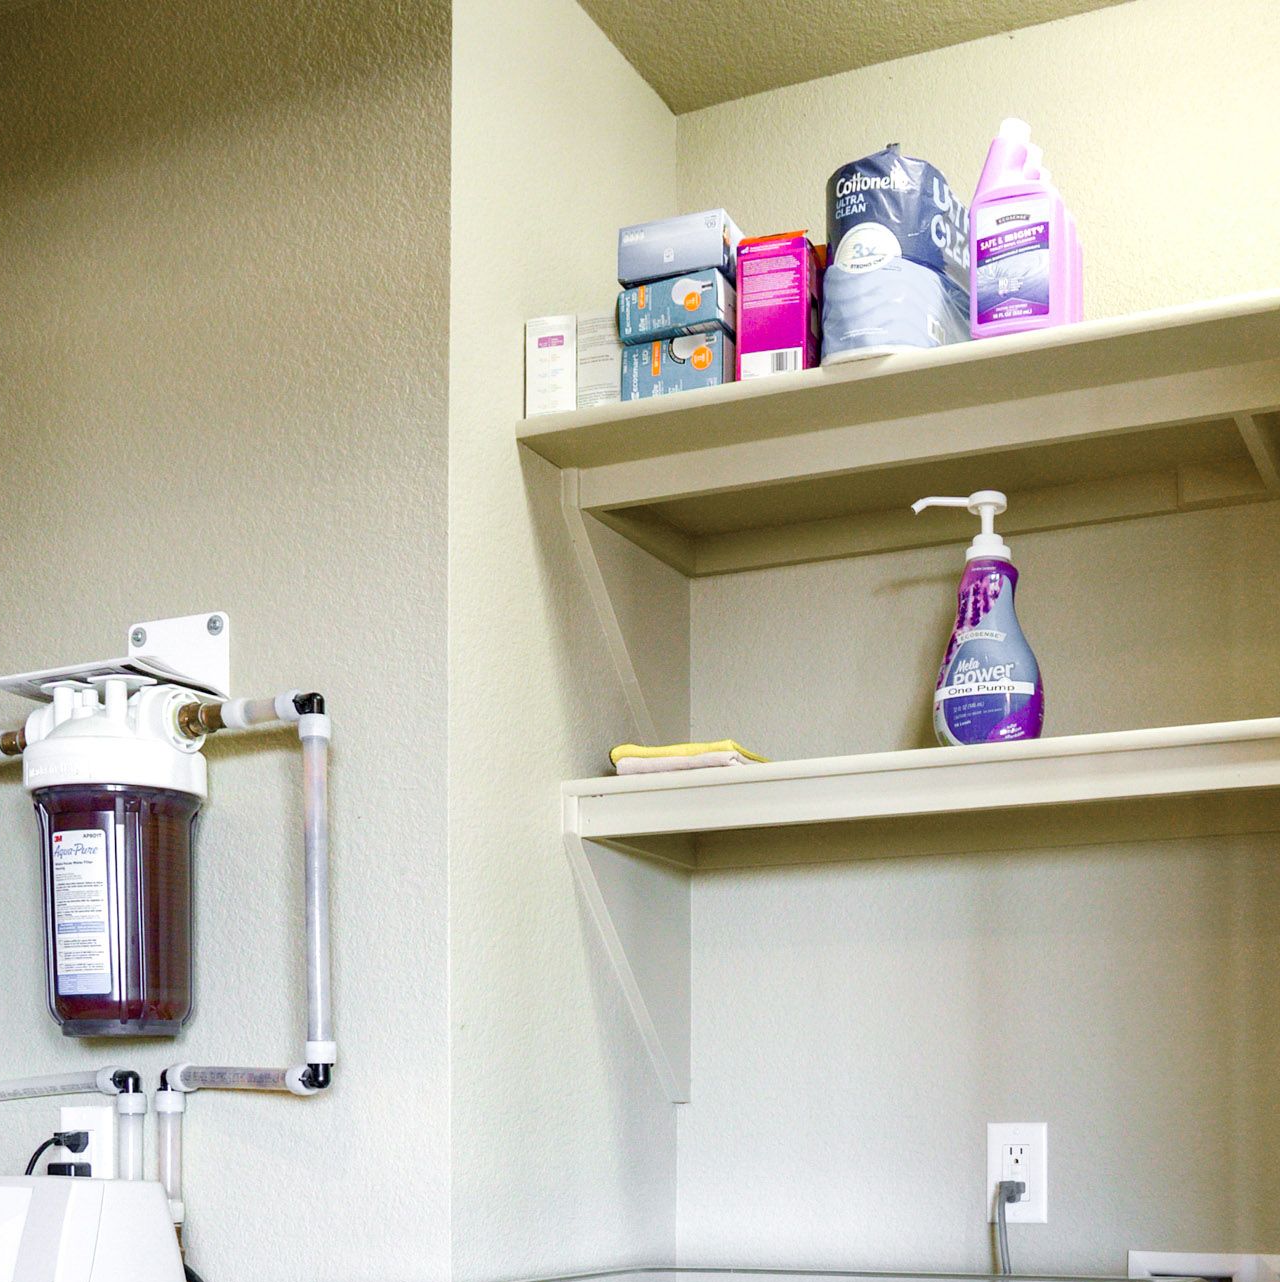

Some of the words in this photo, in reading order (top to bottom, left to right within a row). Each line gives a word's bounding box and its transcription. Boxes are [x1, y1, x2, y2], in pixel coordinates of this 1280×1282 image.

[836, 169, 908, 198] Cottonel
[836, 193, 865, 210] ULTRA
[835, 202, 867, 219] CLEAN
[948, 687, 972, 695] One
[977, 684, 1016, 692] Pump
